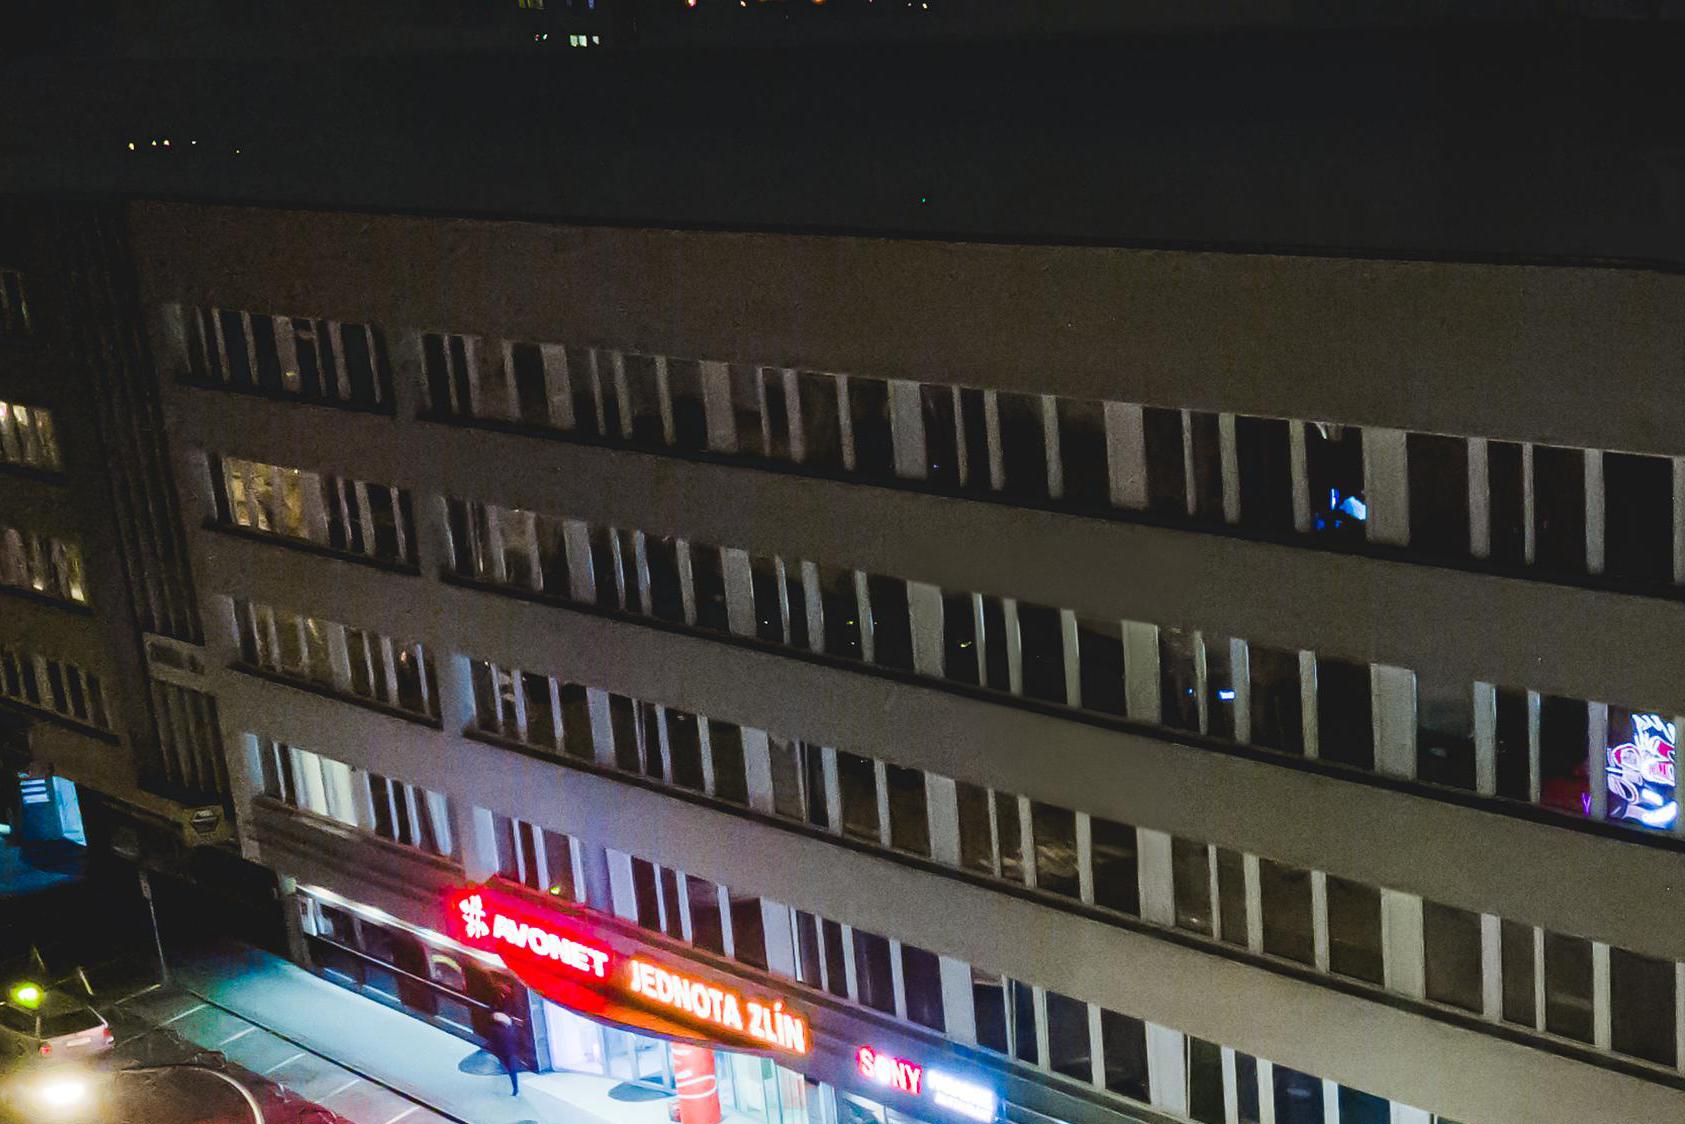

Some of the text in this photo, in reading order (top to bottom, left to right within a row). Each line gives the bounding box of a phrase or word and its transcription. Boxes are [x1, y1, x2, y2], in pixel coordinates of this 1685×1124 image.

[492, 914, 609, 977] AVONET
[629, 958, 806, 1054] JEDNOTA ZLÍN
[857, 1046, 922, 1095] SONY
